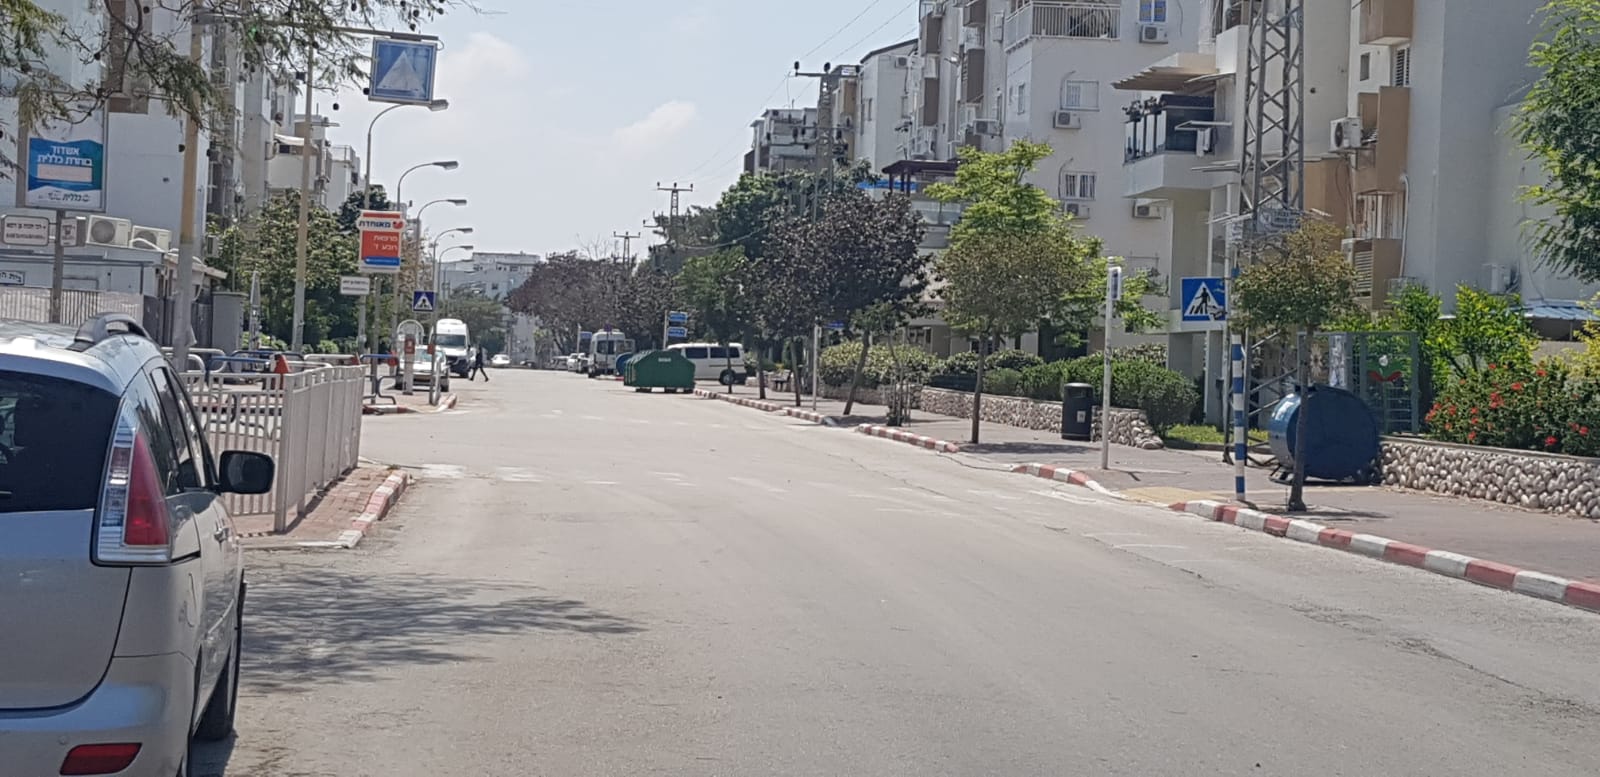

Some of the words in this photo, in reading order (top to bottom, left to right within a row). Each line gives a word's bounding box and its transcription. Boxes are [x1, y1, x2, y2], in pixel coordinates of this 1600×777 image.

[50, 145, 80, 156] אשדוד
[37, 153, 63, 164] כללית
[359, 220, 391, 228] מאוחדת
